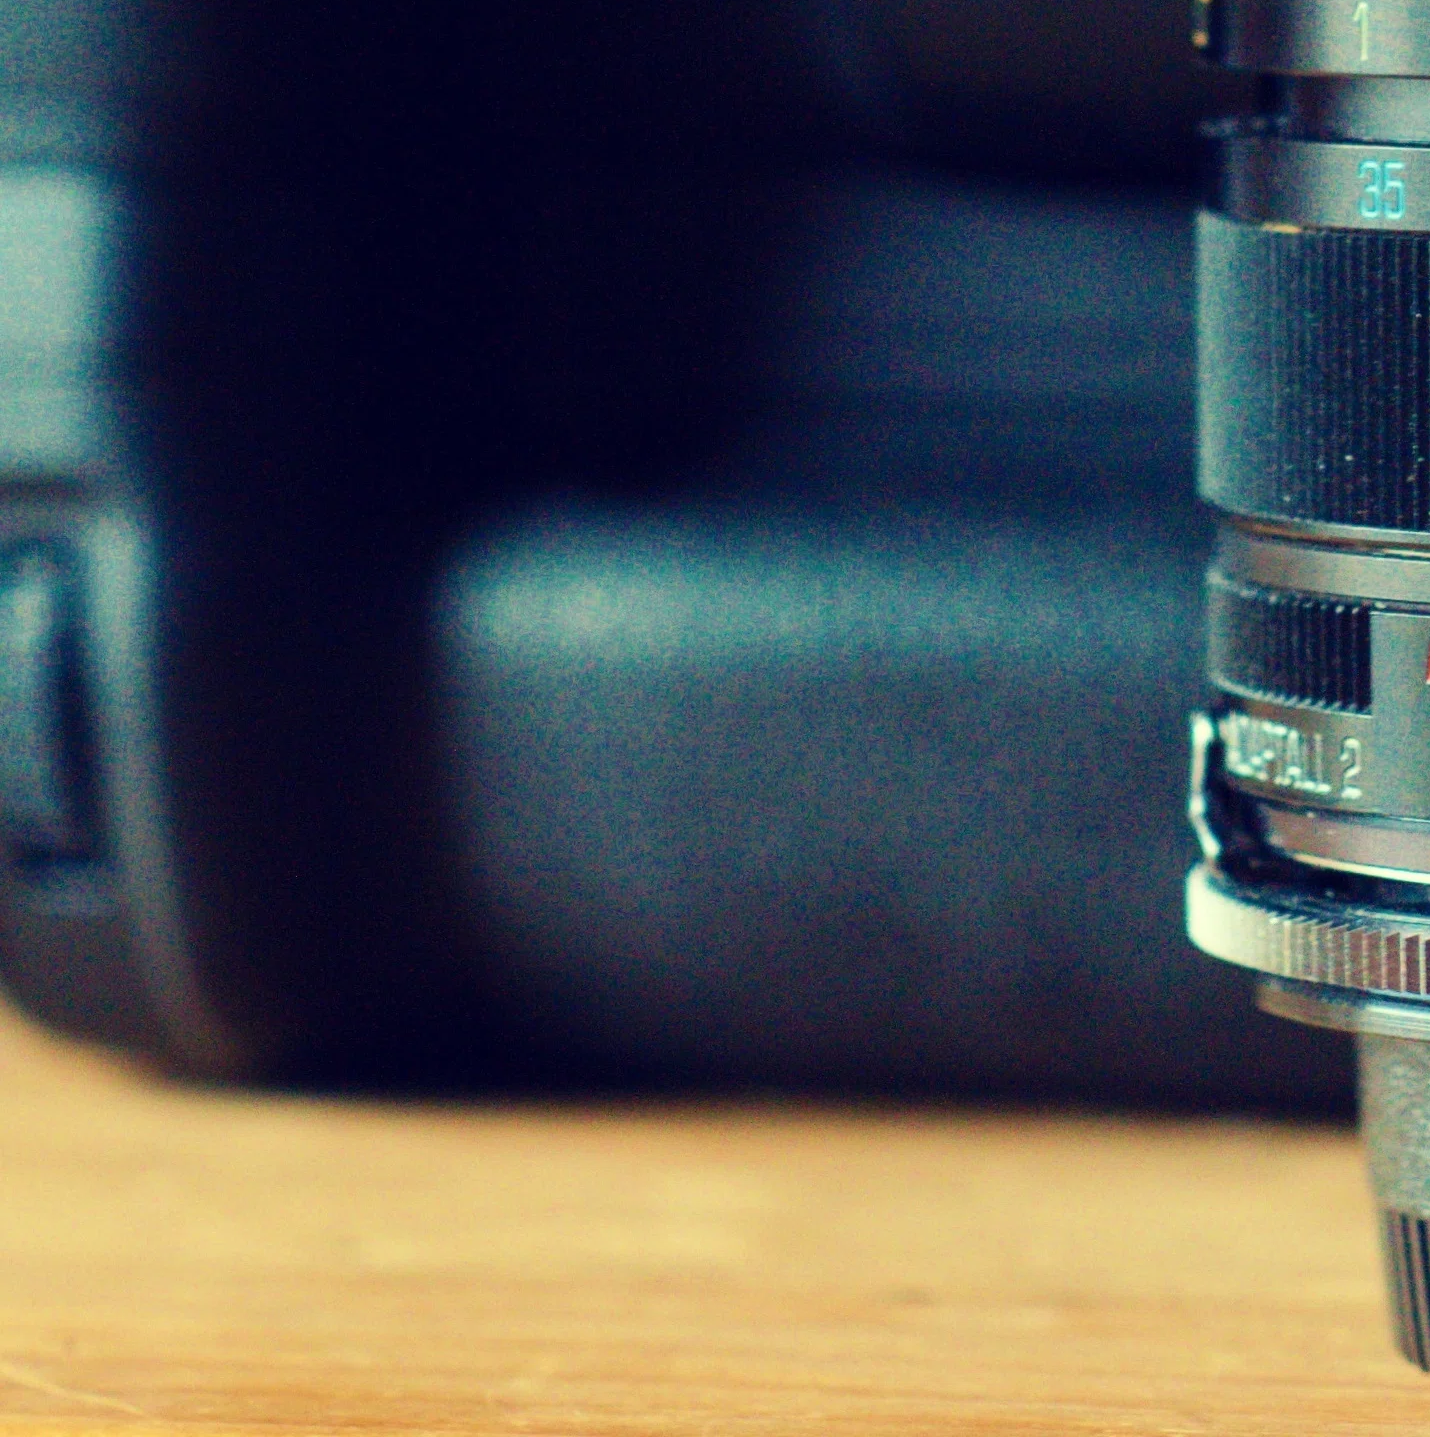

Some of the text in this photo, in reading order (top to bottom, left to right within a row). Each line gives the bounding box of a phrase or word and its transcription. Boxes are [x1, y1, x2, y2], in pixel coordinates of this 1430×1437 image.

[1352, 1, 1371, 63] 1
[1356, 160, 1406, 220] 35
[1339, 737, 1363, 800] 2
